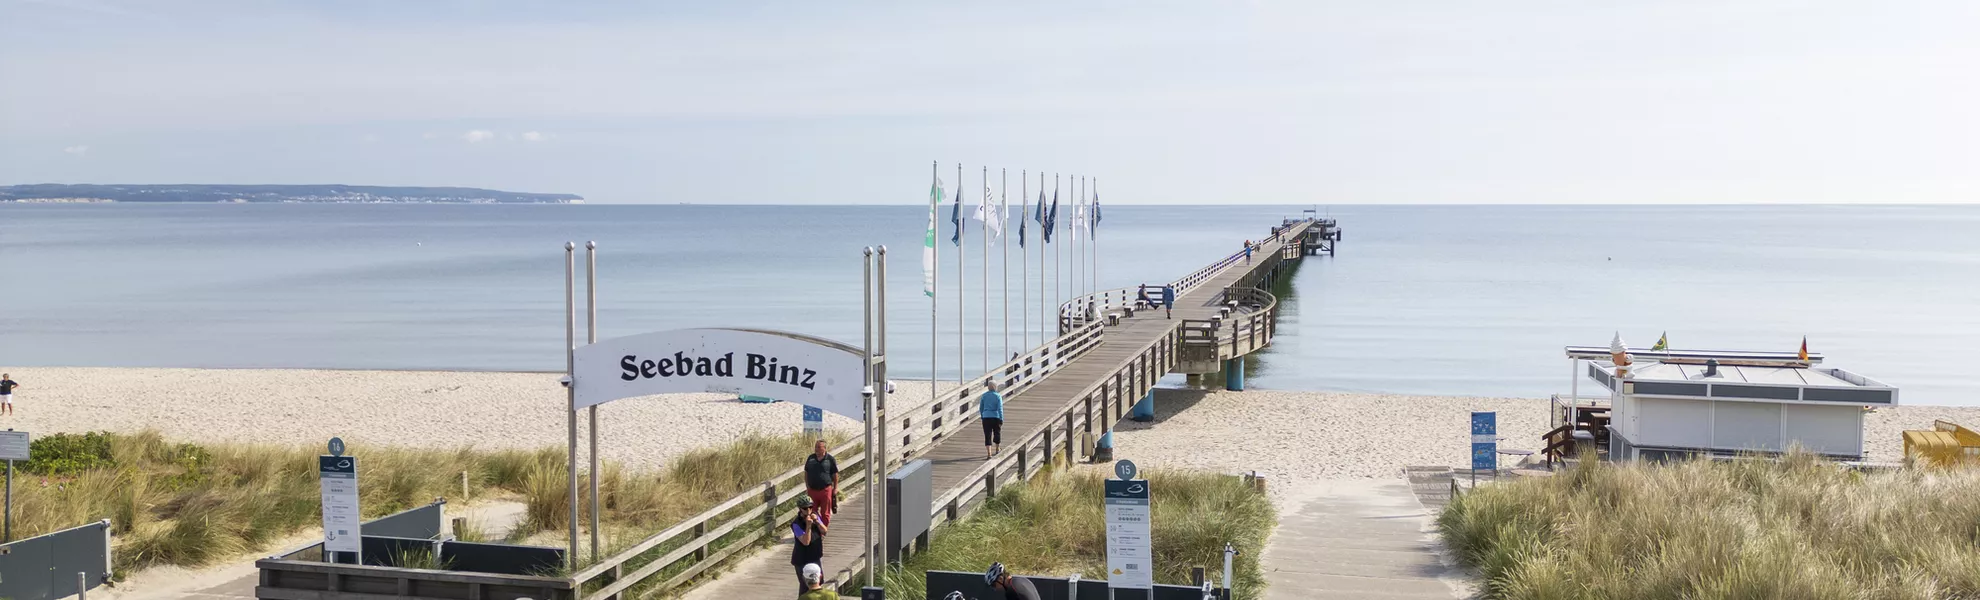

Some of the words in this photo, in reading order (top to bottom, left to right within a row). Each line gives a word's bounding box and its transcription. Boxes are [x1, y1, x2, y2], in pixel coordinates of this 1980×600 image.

[620, 351, 734, 381] Seebad
[745, 353, 817, 390] Binz
[332, 442, 341, 452] 16
[1121, 465, 1131, 475] 15
